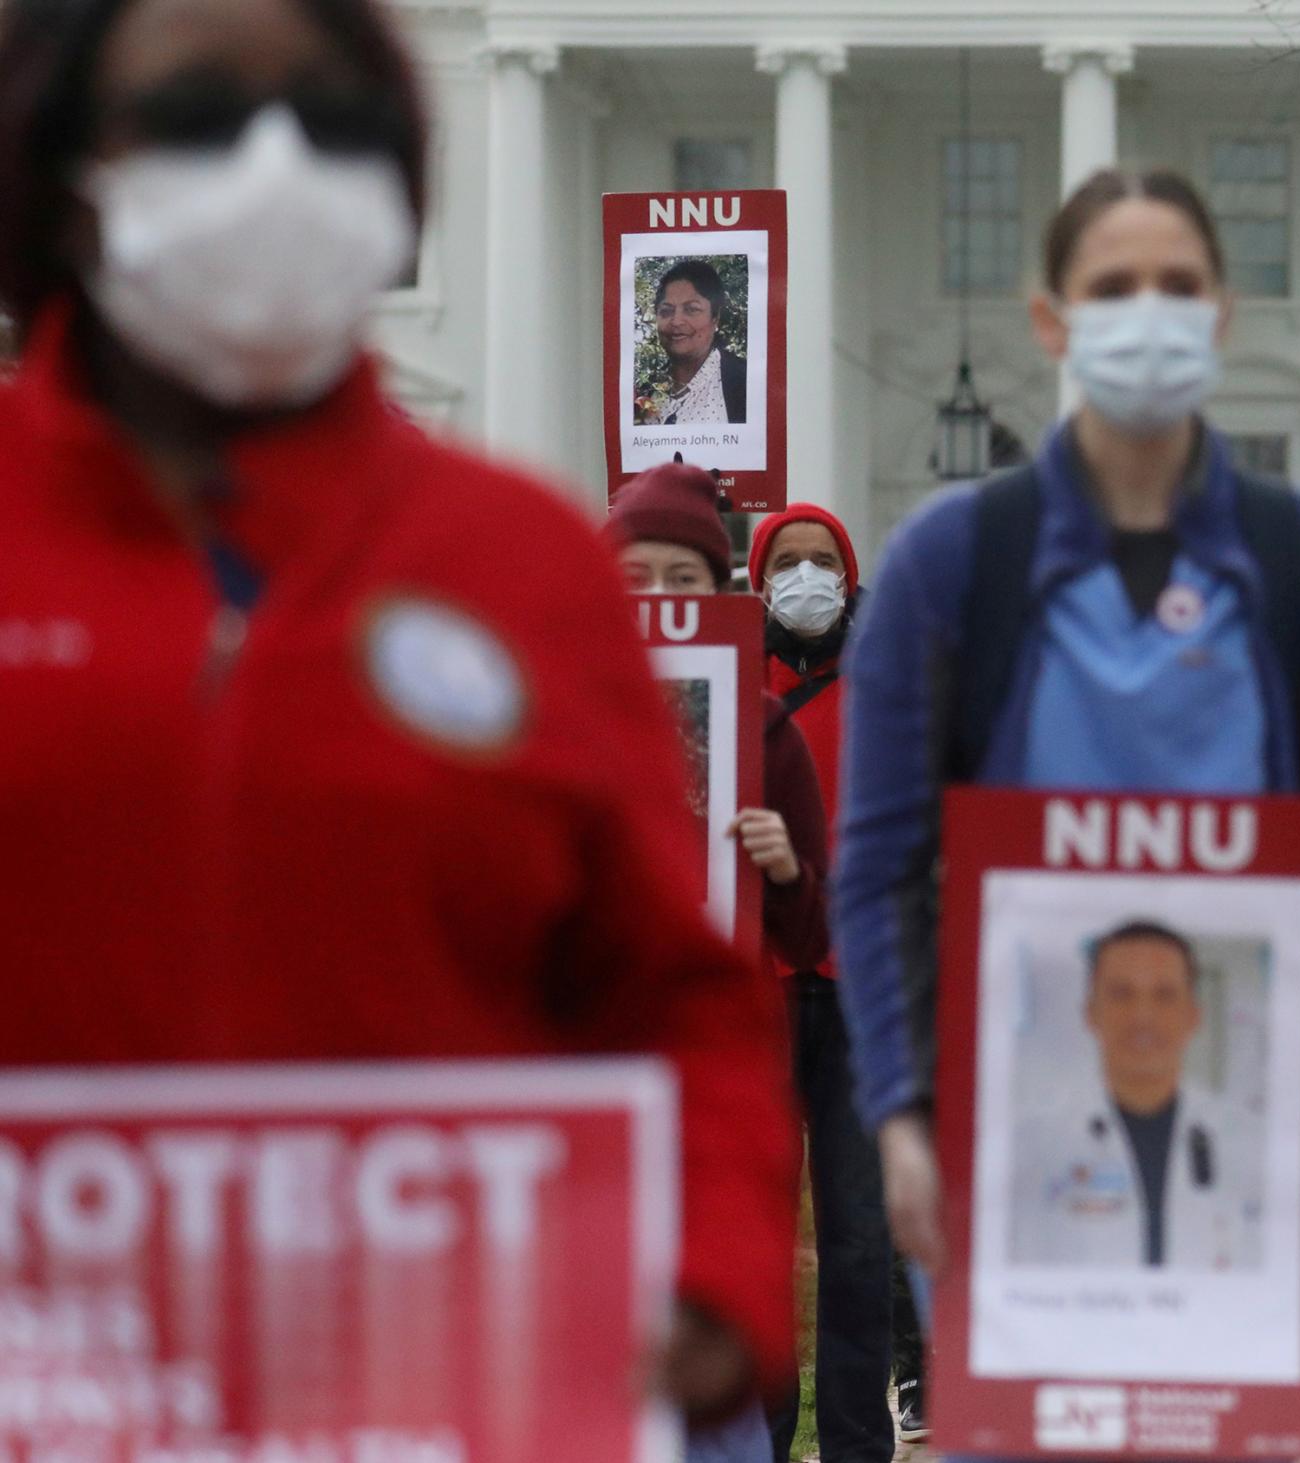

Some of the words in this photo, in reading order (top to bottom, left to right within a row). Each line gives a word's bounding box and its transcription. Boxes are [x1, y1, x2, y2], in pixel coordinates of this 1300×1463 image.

[649, 197, 741, 228] NNU
[633, 436, 688, 449] Aleyamma
[690, 434, 720, 446] John,
[723, 435, 740, 445] RN
[1044, 798, 1259, 870] NNU
